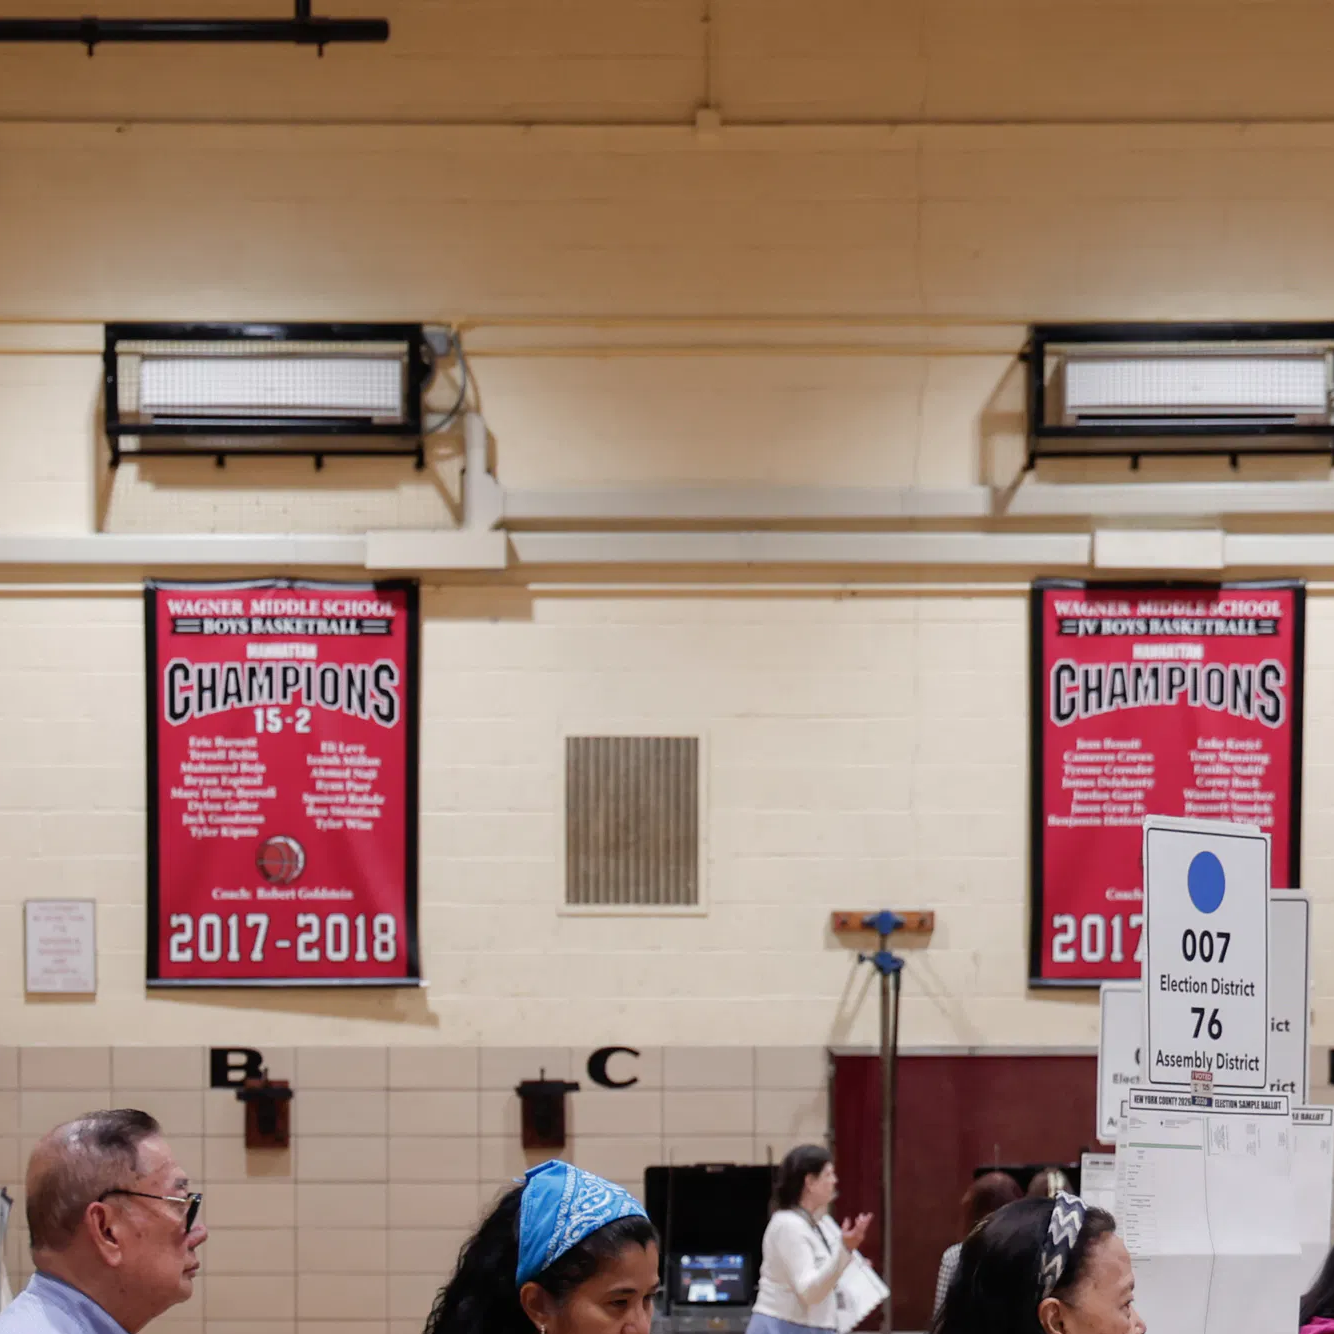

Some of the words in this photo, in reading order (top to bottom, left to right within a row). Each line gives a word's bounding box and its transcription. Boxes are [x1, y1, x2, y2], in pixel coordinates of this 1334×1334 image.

[167, 599, 243, 615] WAGNER
[250, 599, 320, 616] MIDDLE
[322, 599, 396, 617] SCHOOL
[1054, 600, 1131, 616] WAGNER
[1136, 600, 1206, 617] MIDDLE
[1209, 600, 1283, 617] SCHOOL
[203, 618, 250, 635] BOYS
[251, 618, 361, 635] BASKETBALL
[1078, 618, 1099, 637] JV
[1101, 618, 1147, 636] BOYS
[1149, 618, 1258, 636] BASKETBALL
[164, 657, 400, 729] CHAMPIONS
[1050, 658, 1286, 729] CHAMPIONS
[256, 887, 296, 901] Robert
[1181, 928, 1231, 964] 007
[1160, 974, 1208, 994] Election
[1211, 977, 1255, 997] District
[1190, 1006, 1223, 1041] 76
[210, 1048, 266, 1089] B
[586, 1045, 642, 1089] C
[1155, 1049, 1213, 1072] Assembly
[1216, 1052, 1260, 1072] District
[1196, 1071, 1213, 1081] VOTED
[1144, 1095, 1157, 1104] YORK
[1159, 1096, 1177, 1105] COUNTY
[1214, 1098, 1238, 1108] ELECTION
[1238, 1099, 1260, 1109] SAMPLE
[1261, 1100, 1281, 1110] BALLOT
